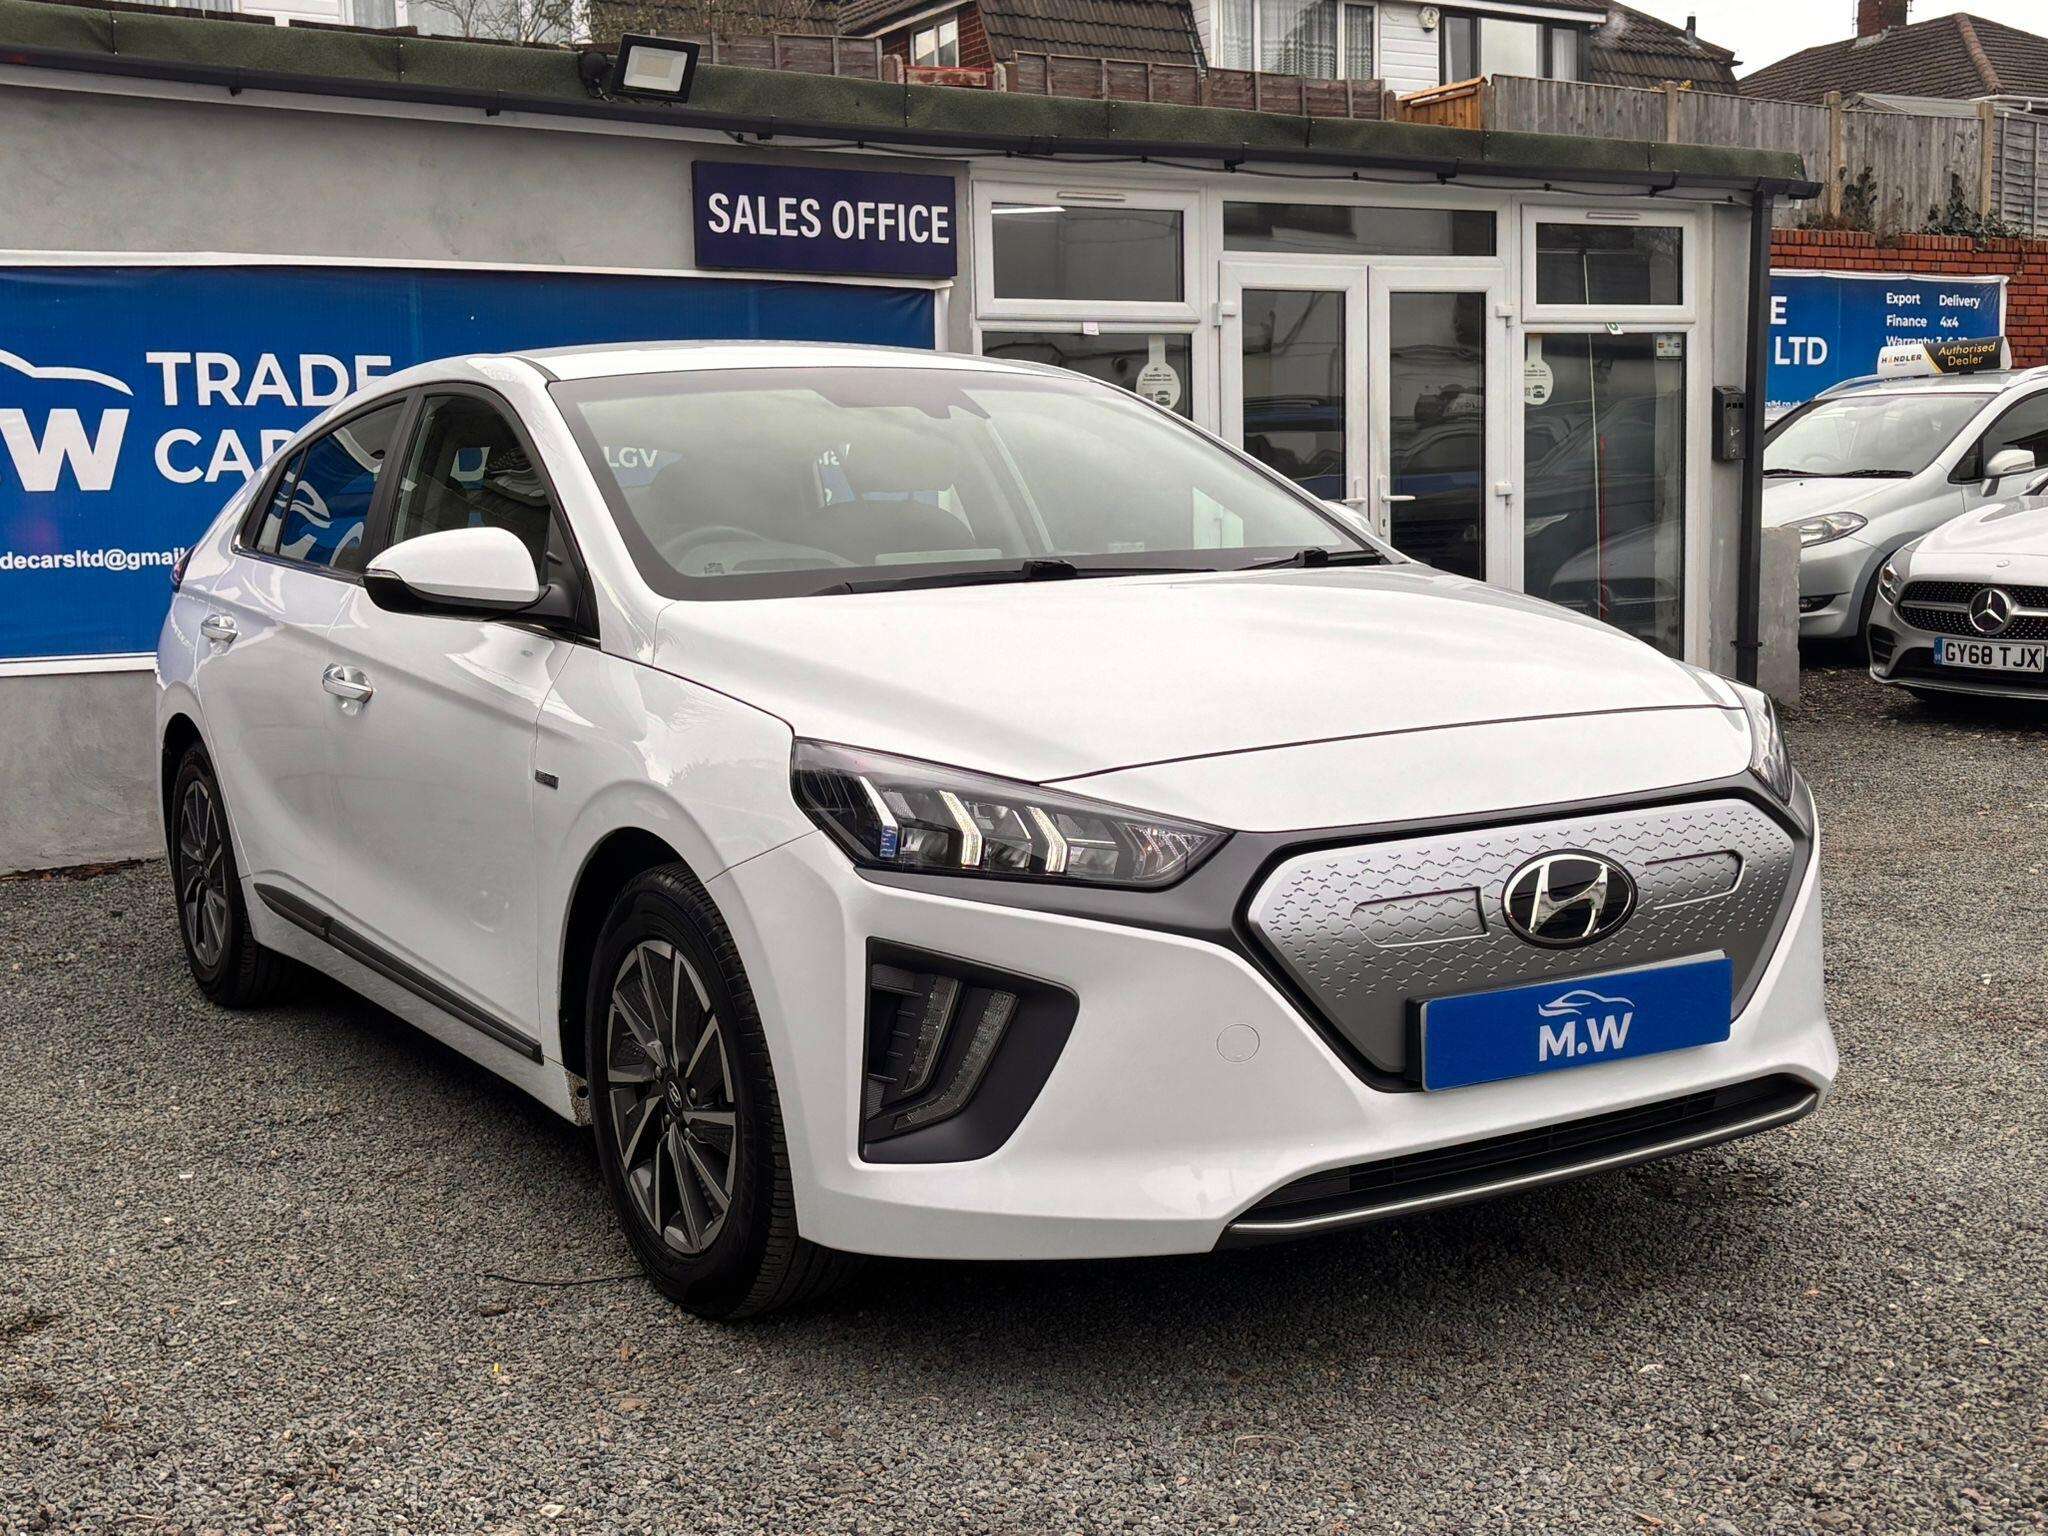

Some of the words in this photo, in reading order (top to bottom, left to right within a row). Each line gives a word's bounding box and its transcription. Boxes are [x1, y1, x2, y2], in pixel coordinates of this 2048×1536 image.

[708, 192, 822, 238] SALES
[832, 200, 949, 244] OFFICE
[1770, 296, 1787, 324] E
[1886, 292, 1921, 306] Export
[1939, 294, 1980, 309] Delivery
[1886, 314, 1927, 327] Finance
[1940, 316, 1959, 328] 4x4
[1775, 336, 1828, 365] LTD
[1938, 342, 1996, 355] Authorised
[1946, 354, 1983, 366] Dealer
[145, 352, 391, 406] TRADE
[0, 408, 130, 492] W
[603, 446, 658, 468] LGV
[1945, 642, 1993, 665] GY68
[1999, 647, 2040, 668] TJX
[1539, 1012, 1633, 1062] M.W
